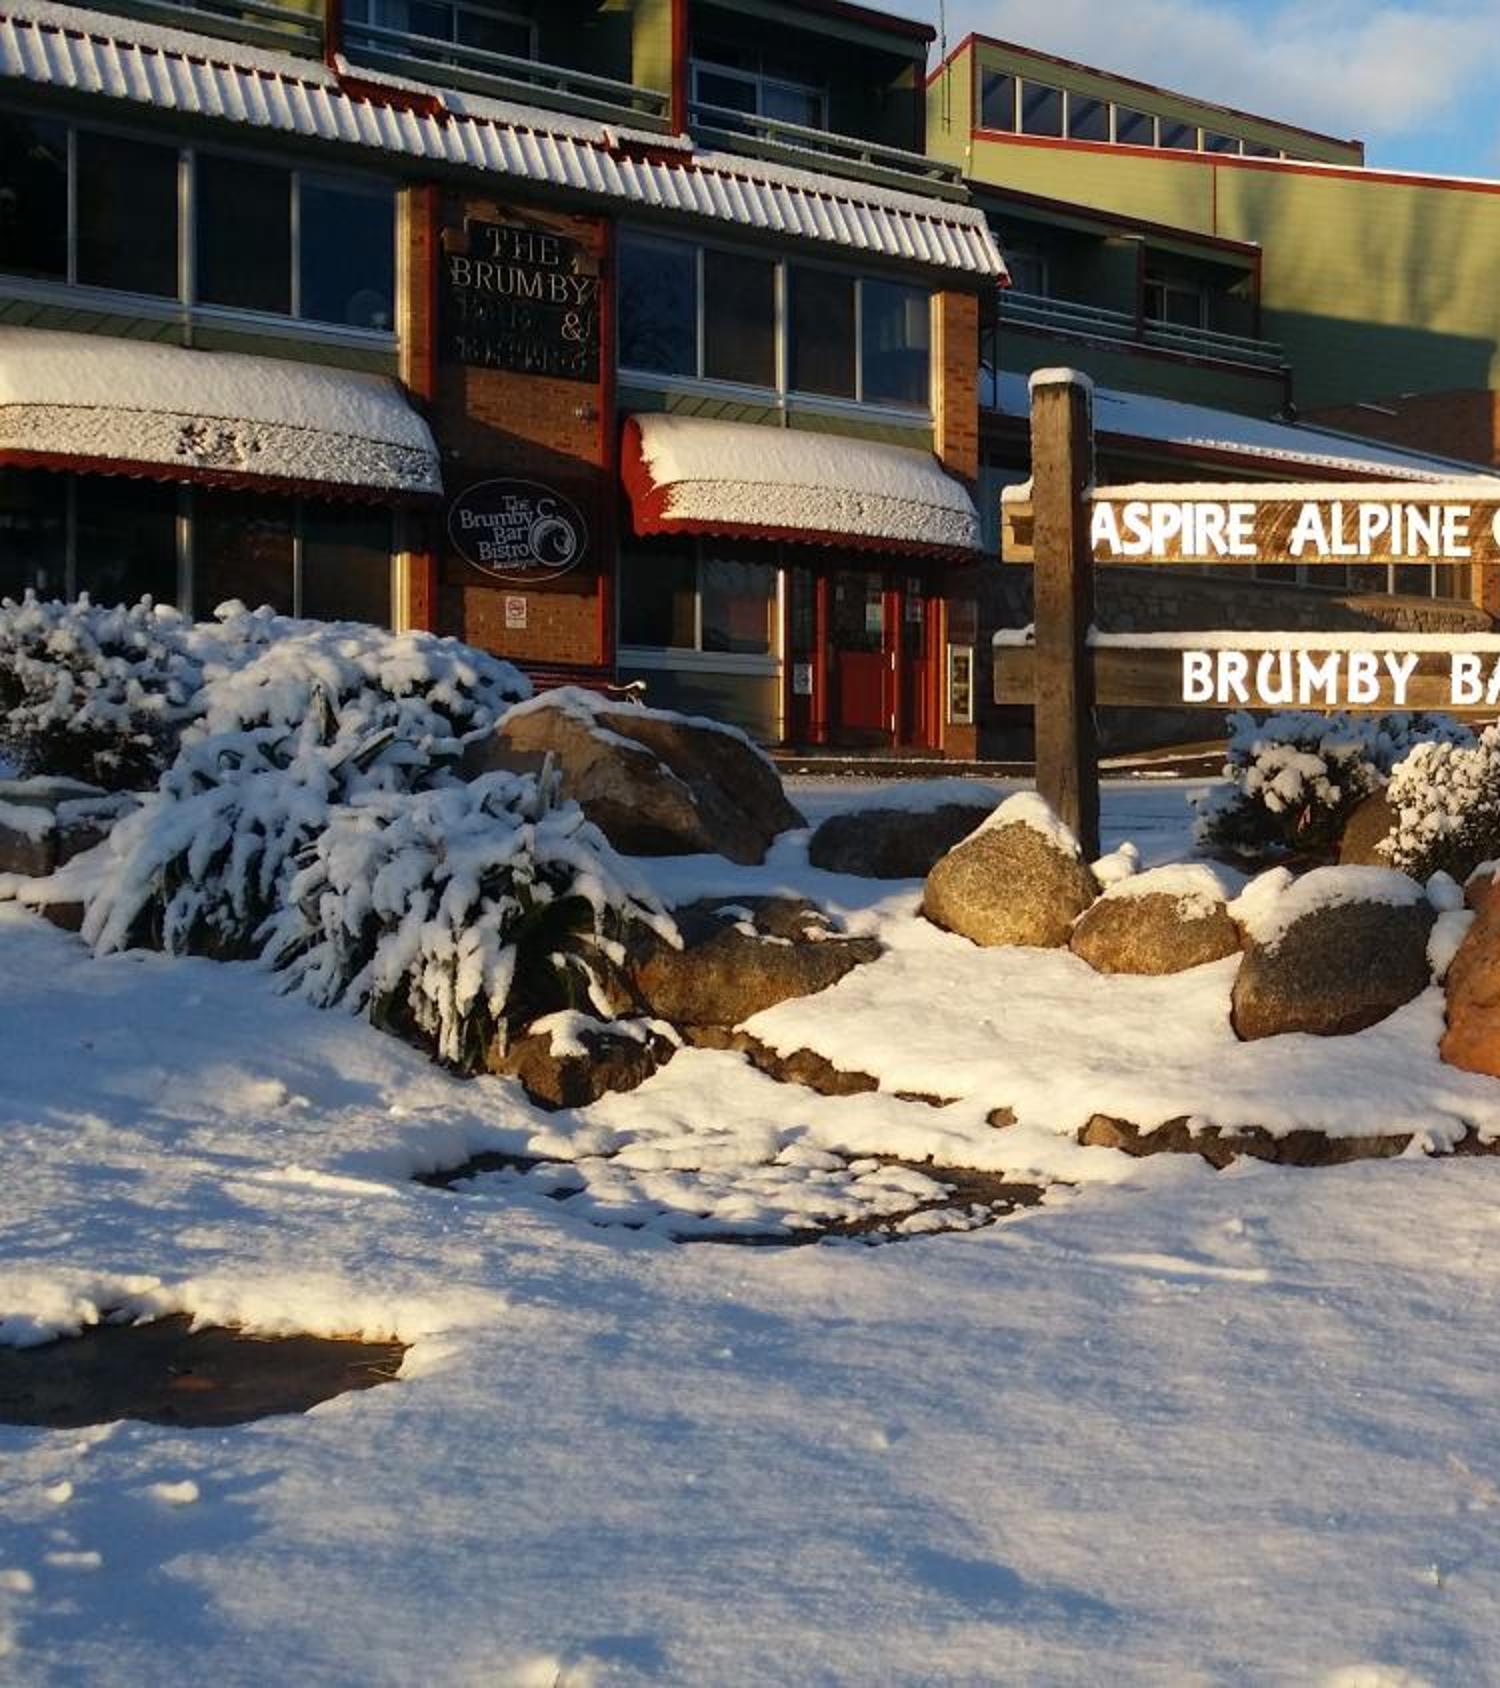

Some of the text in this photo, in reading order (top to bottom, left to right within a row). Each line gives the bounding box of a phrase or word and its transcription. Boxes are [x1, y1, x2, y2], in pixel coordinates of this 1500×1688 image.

[485, 227, 560, 266] THE
[449, 255, 592, 305] BRUMBY
[459, 508, 535, 529] Brumby
[501, 495, 530, 512] The
[493, 526, 529, 545] Bar
[1091, 501, 1257, 556] ASPIRE
[1289, 502, 1472, 556] ALPINE
[477, 540, 530, 562] Bistro
[1181, 650, 1419, 705] BRUMBY
